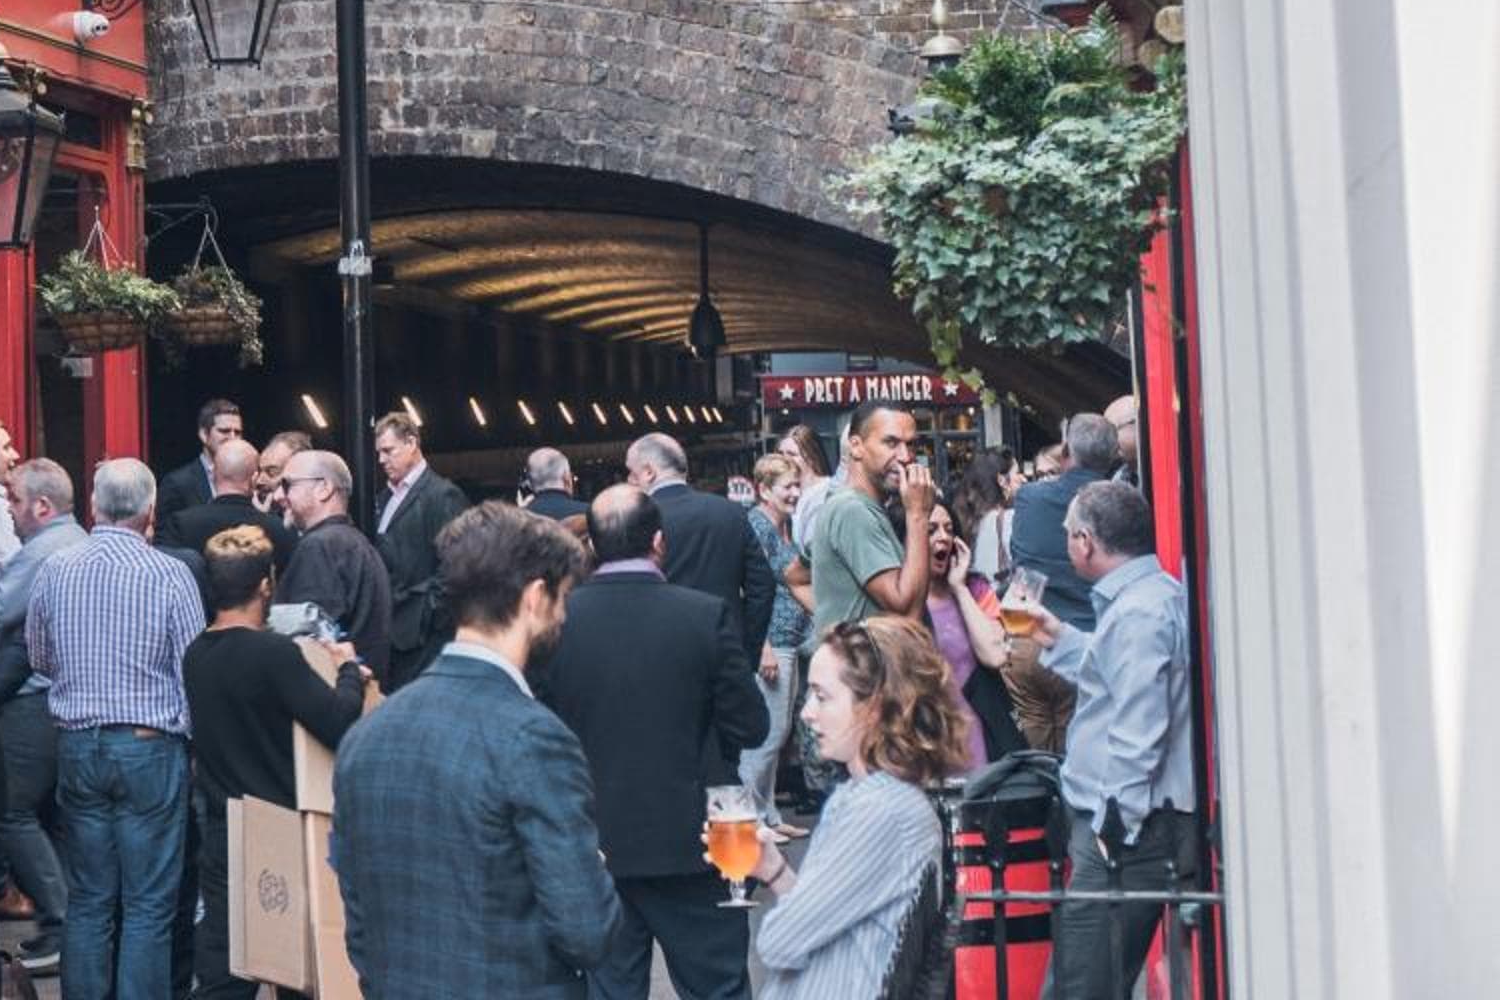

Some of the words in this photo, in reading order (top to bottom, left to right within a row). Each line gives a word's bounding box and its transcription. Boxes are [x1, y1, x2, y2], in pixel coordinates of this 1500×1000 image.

[805, 378, 845, 403] PRET
[850, 378, 861, 401] A
[865, 375, 933, 401] MANGER
